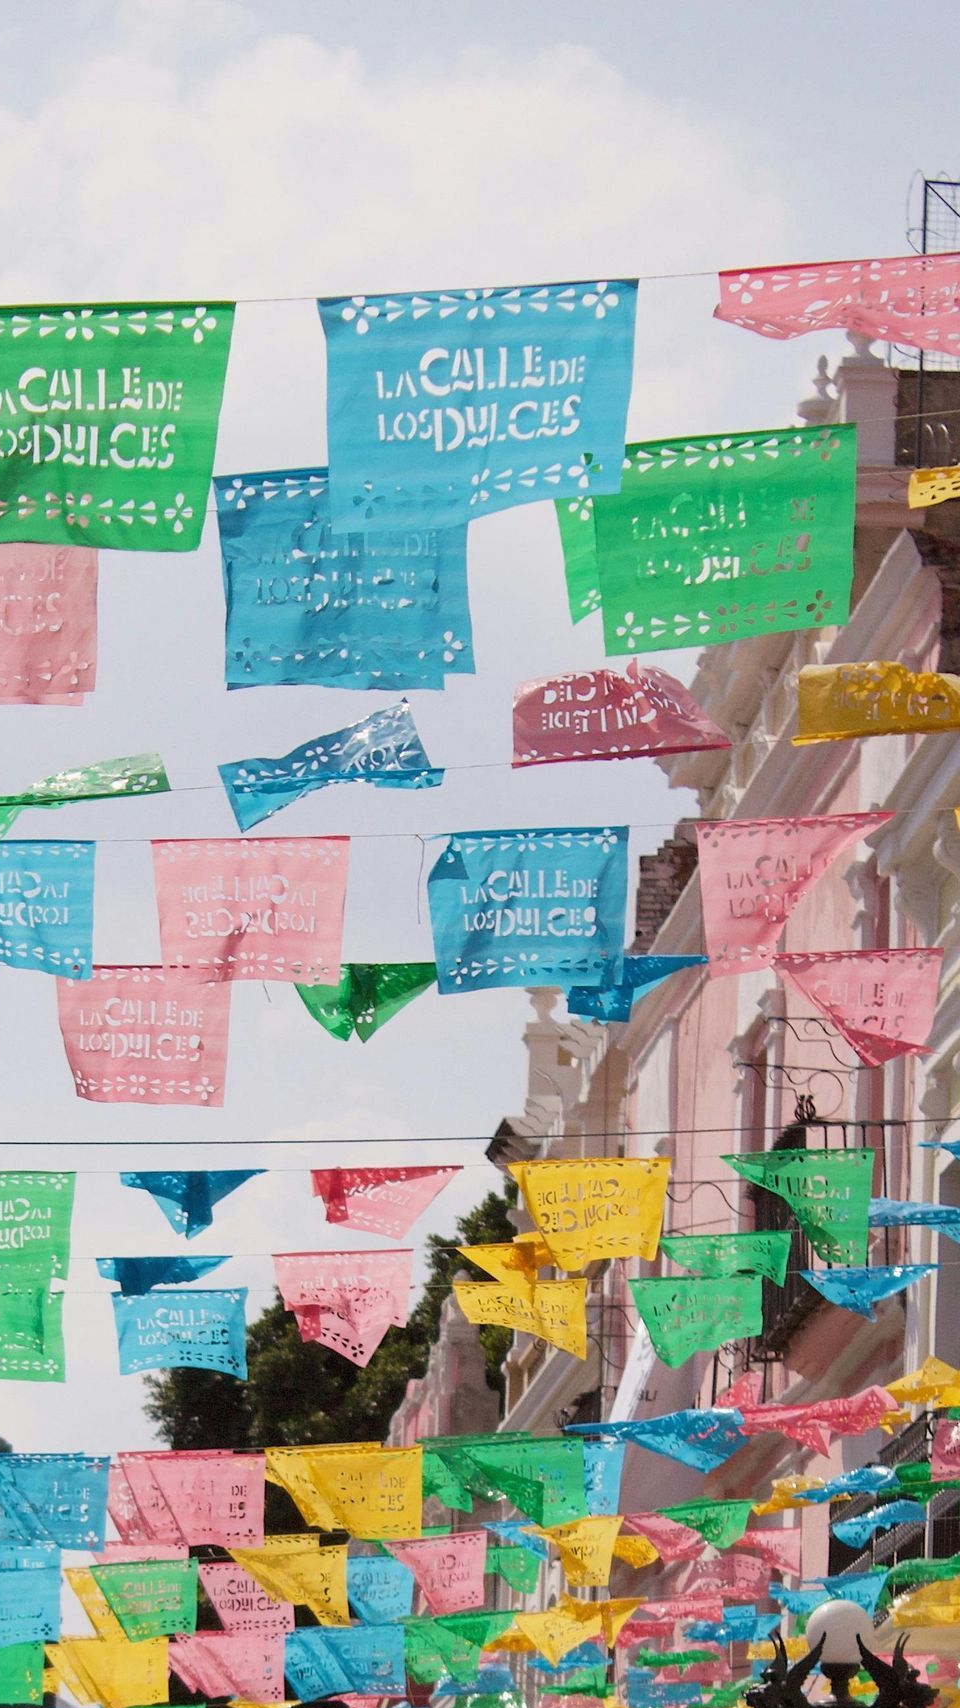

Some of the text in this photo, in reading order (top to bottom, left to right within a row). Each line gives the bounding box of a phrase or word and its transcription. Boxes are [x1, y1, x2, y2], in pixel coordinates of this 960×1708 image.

[18, 366, 142, 413] CALLE
[147, 381, 183, 411] DE
[376, 345, 587, 400] LA CALLE DE
[378, 394, 582, 453] LOS DULCES
[32, 422, 176, 470] DULCES
[460, 869, 598, 905] LA CALLE DE
[463, 906, 597, 938] LOS DULCES
[79, 997, 204, 1028] LA CALLE DE
[79, 1032, 202, 1062] LOS DULCES
